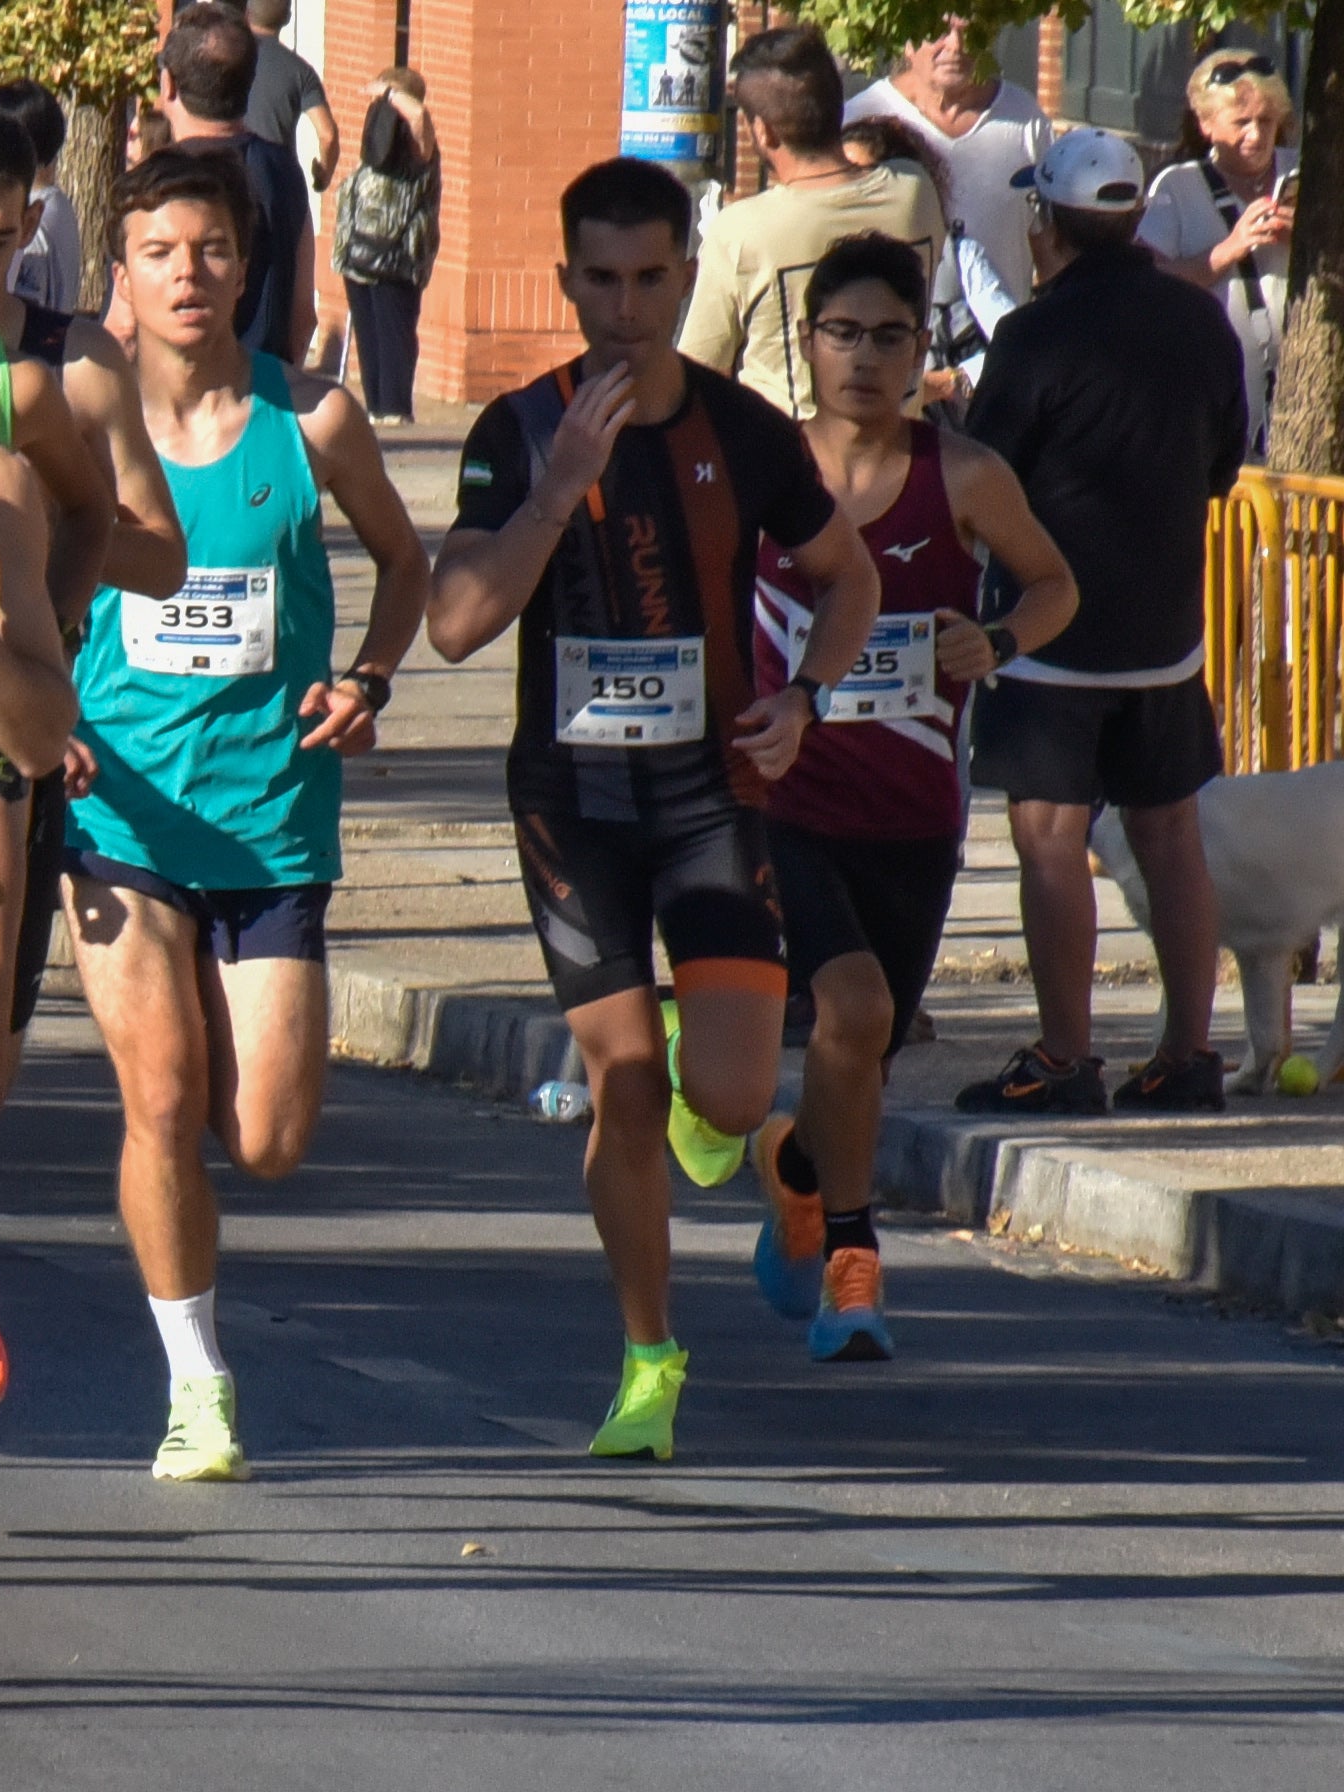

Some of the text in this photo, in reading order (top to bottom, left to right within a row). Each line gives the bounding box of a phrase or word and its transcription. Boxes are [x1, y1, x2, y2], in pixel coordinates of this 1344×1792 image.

[658, 8, 703, 21] LOCAL
[161, 604, 233, 628] 353
[591, 675, 665, 699] 150
